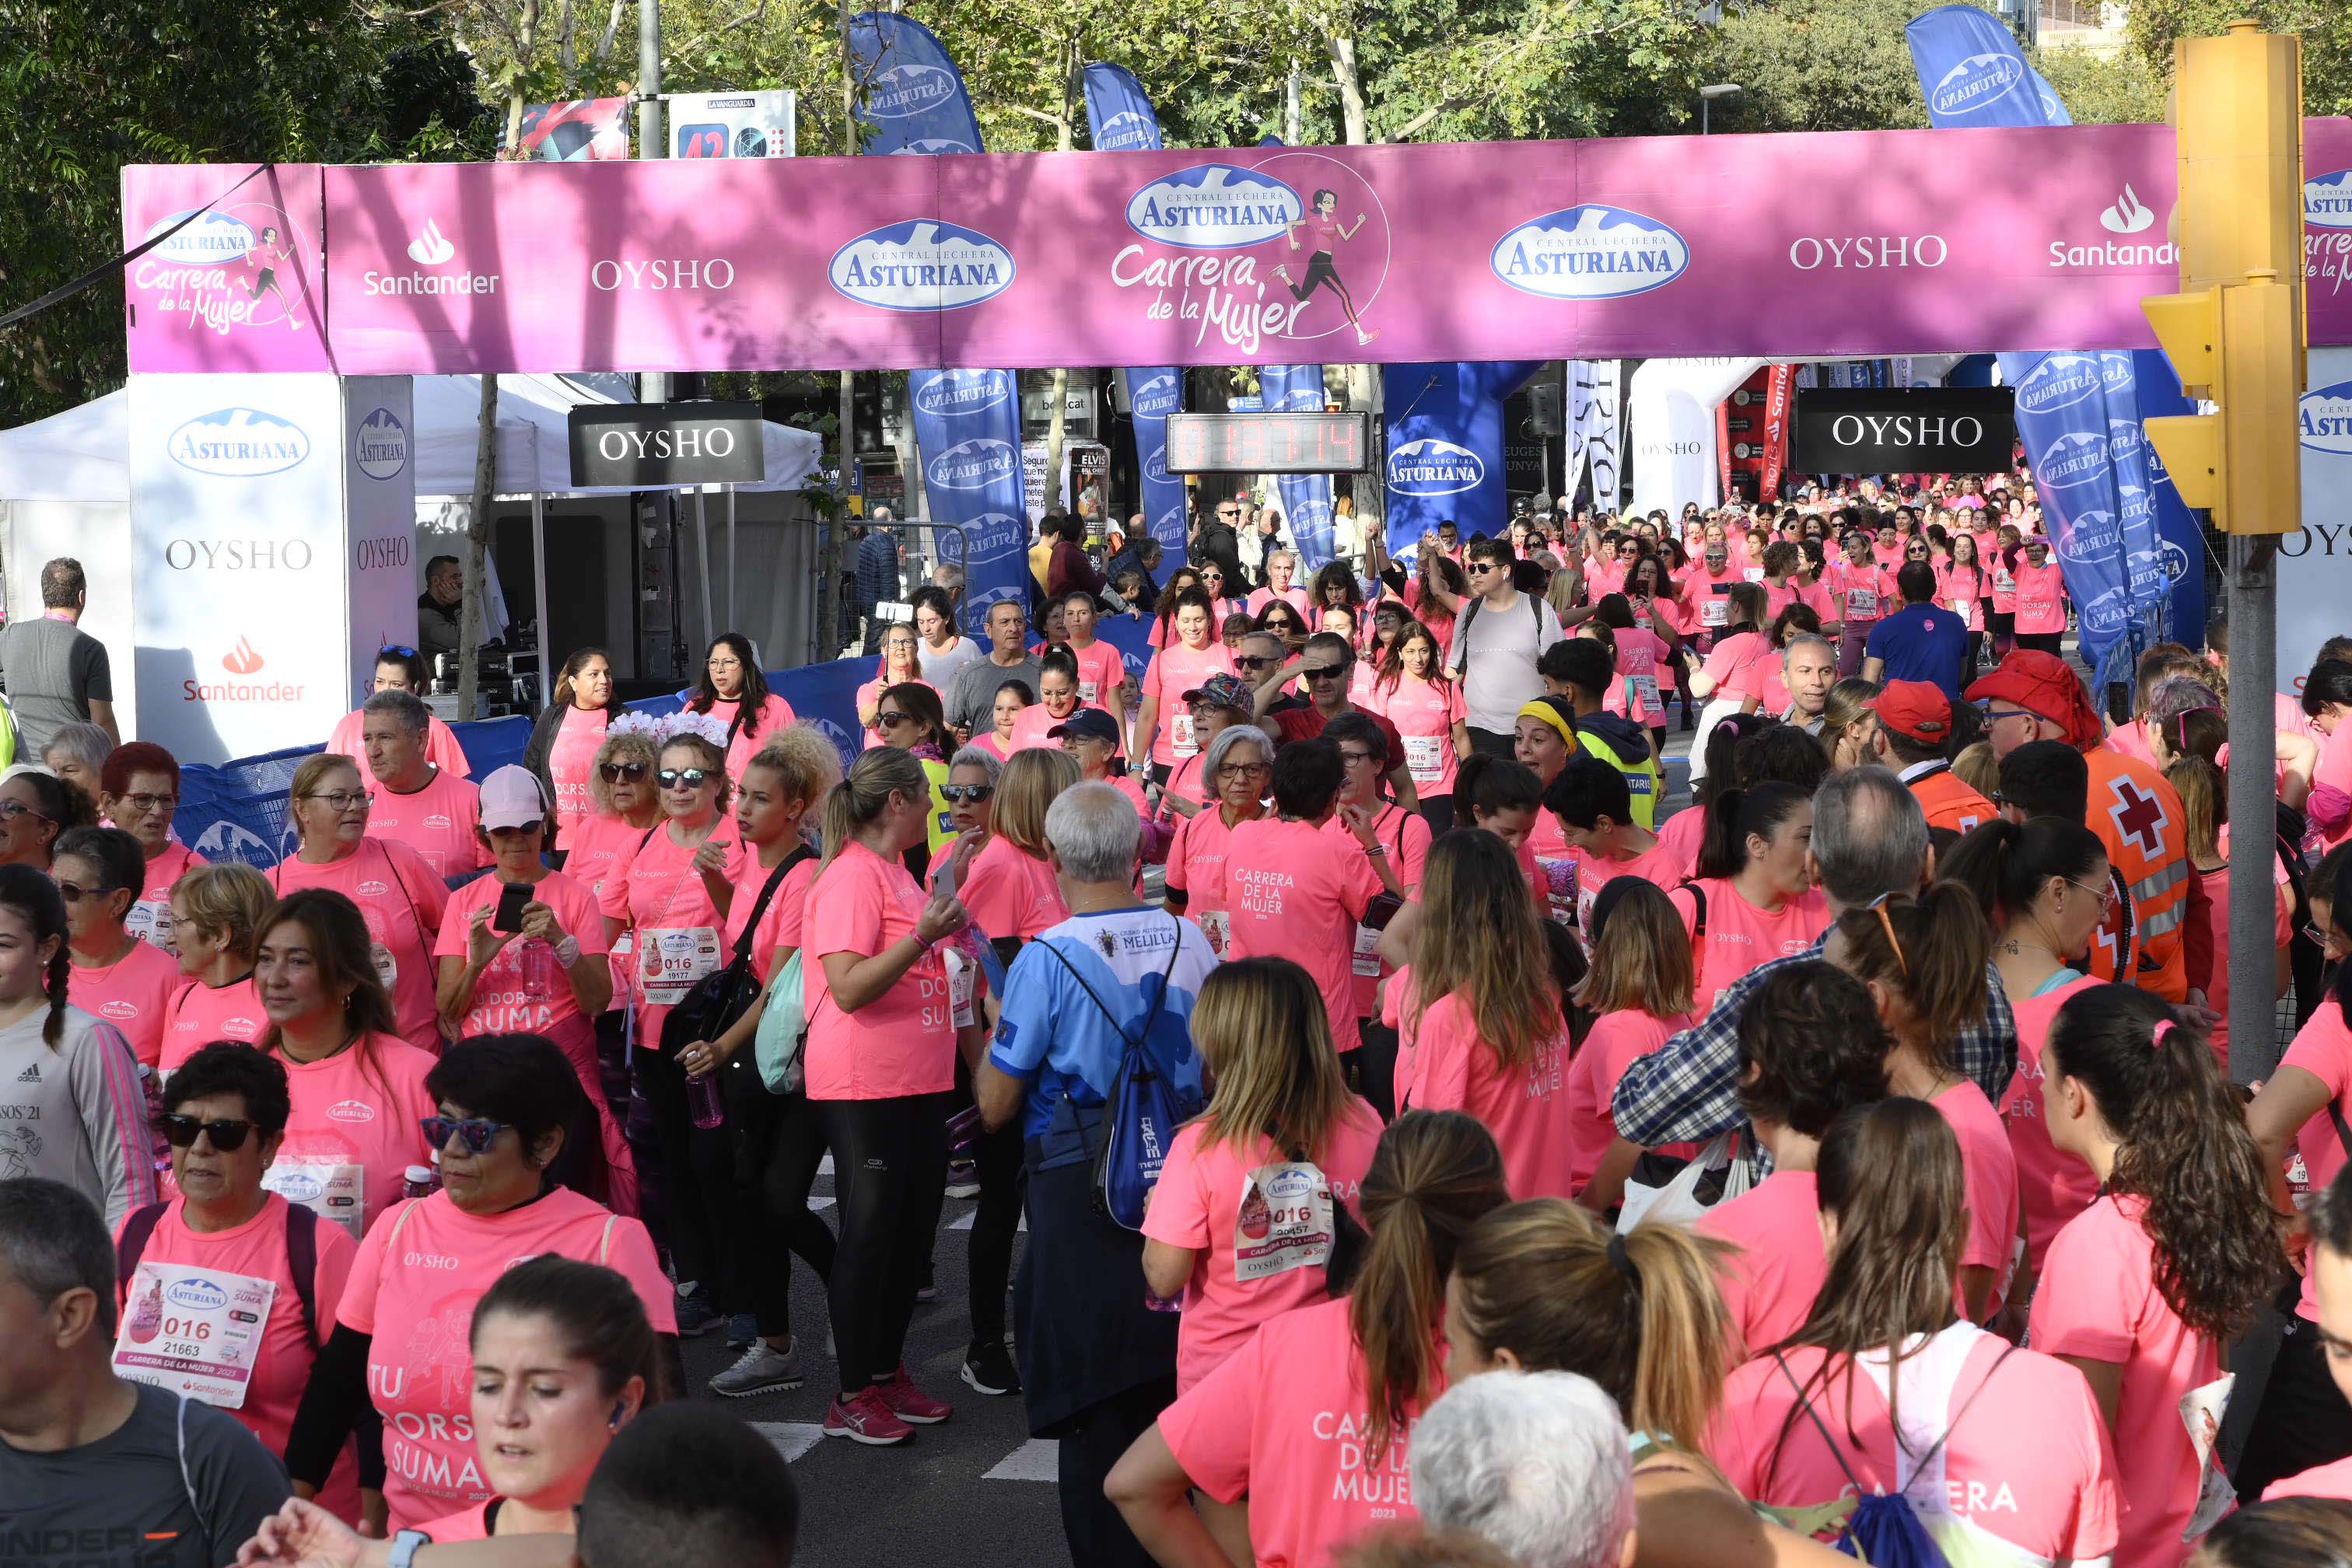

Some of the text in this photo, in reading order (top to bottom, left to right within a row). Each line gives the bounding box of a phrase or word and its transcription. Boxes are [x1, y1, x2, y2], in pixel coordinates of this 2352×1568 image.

[1167, 192, 1284, 201] CENTRAL LECHERA
[1139, 196, 1288, 227] ASTURIANA
[1536, 236, 1668, 247] CENTRAL LECHERA
[871, 250, 995, 261] CENTRAL LECHERA
[1505, 241, 1675, 276] ASTURIANA
[1789, 235, 1948, 269] OYSHO
[591, 257, 735, 291] OYSHO
[843, 254, 1002, 287] ASTURIANA
[1111, 243, 1257, 287] Carrera
[135, 261, 226, 290] Carrera
[363, 269, 499, 295] Santander
[159, 288, 261, 335] de la Mujer
[1147, 282, 1311, 355] de la Mujer
[1832, 415, 1983, 446] OYSHO
[179, 435, 300, 460] ASTURIANA
[359, 436, 404, 461] ASTURIANA
[598, 427, 735, 460] OYSHO
[1082, 455, 1106, 465] ELVIS
[1389, 462, 1478, 483] ASTURIANA
[166, 539, 313, 570] OYSHO
[357, 535, 408, 570] OYSHO
[183, 680, 305, 702] Santander
[1171, 703, 1184, 713] TU
[368, 819, 398, 829] OYSHO
[1194, 855, 1223, 863] OYSHO
[634, 870, 669, 878] OYSHO
[1235, 868, 1295, 888] CARRERA
[1580, 867, 1605, 887] OYSHO
[1244, 884, 1282, 901] DE LA
[1241, 897, 1283, 915] MUJER
[1123, 933, 1178, 949] MELILLA
[664, 958, 691, 969] 016
[470, 1004, 554, 1032] SUMA
[17, 1074, 43, 1083] adidas
[1270, 1182, 1309, 1195] ASTURIANA
[1273, 1206, 1312, 1224] 016
[404, 1251, 459, 1270] OYSHO
[1248, 1255, 1284, 1272] OYSHO
[170, 1286, 222, 1306] ASTURIANA
[233, 1293, 262, 1305] SUMA
[164, 1318, 212, 1339] 016
[163, 1341, 201, 1357] 21663
[127, 1355, 162, 1366] CARRERA
[163, 1360, 175, 1368] DE
[176, 1361, 187, 1370] LA
[188, 1363, 215, 1374] MUJER
[192, 1381, 236, 1397] Santander
[369, 1363, 403, 1398] TU
[391, 1440, 485, 1489] SUMA
[1370, 1508, 1397, 1518] 2023
